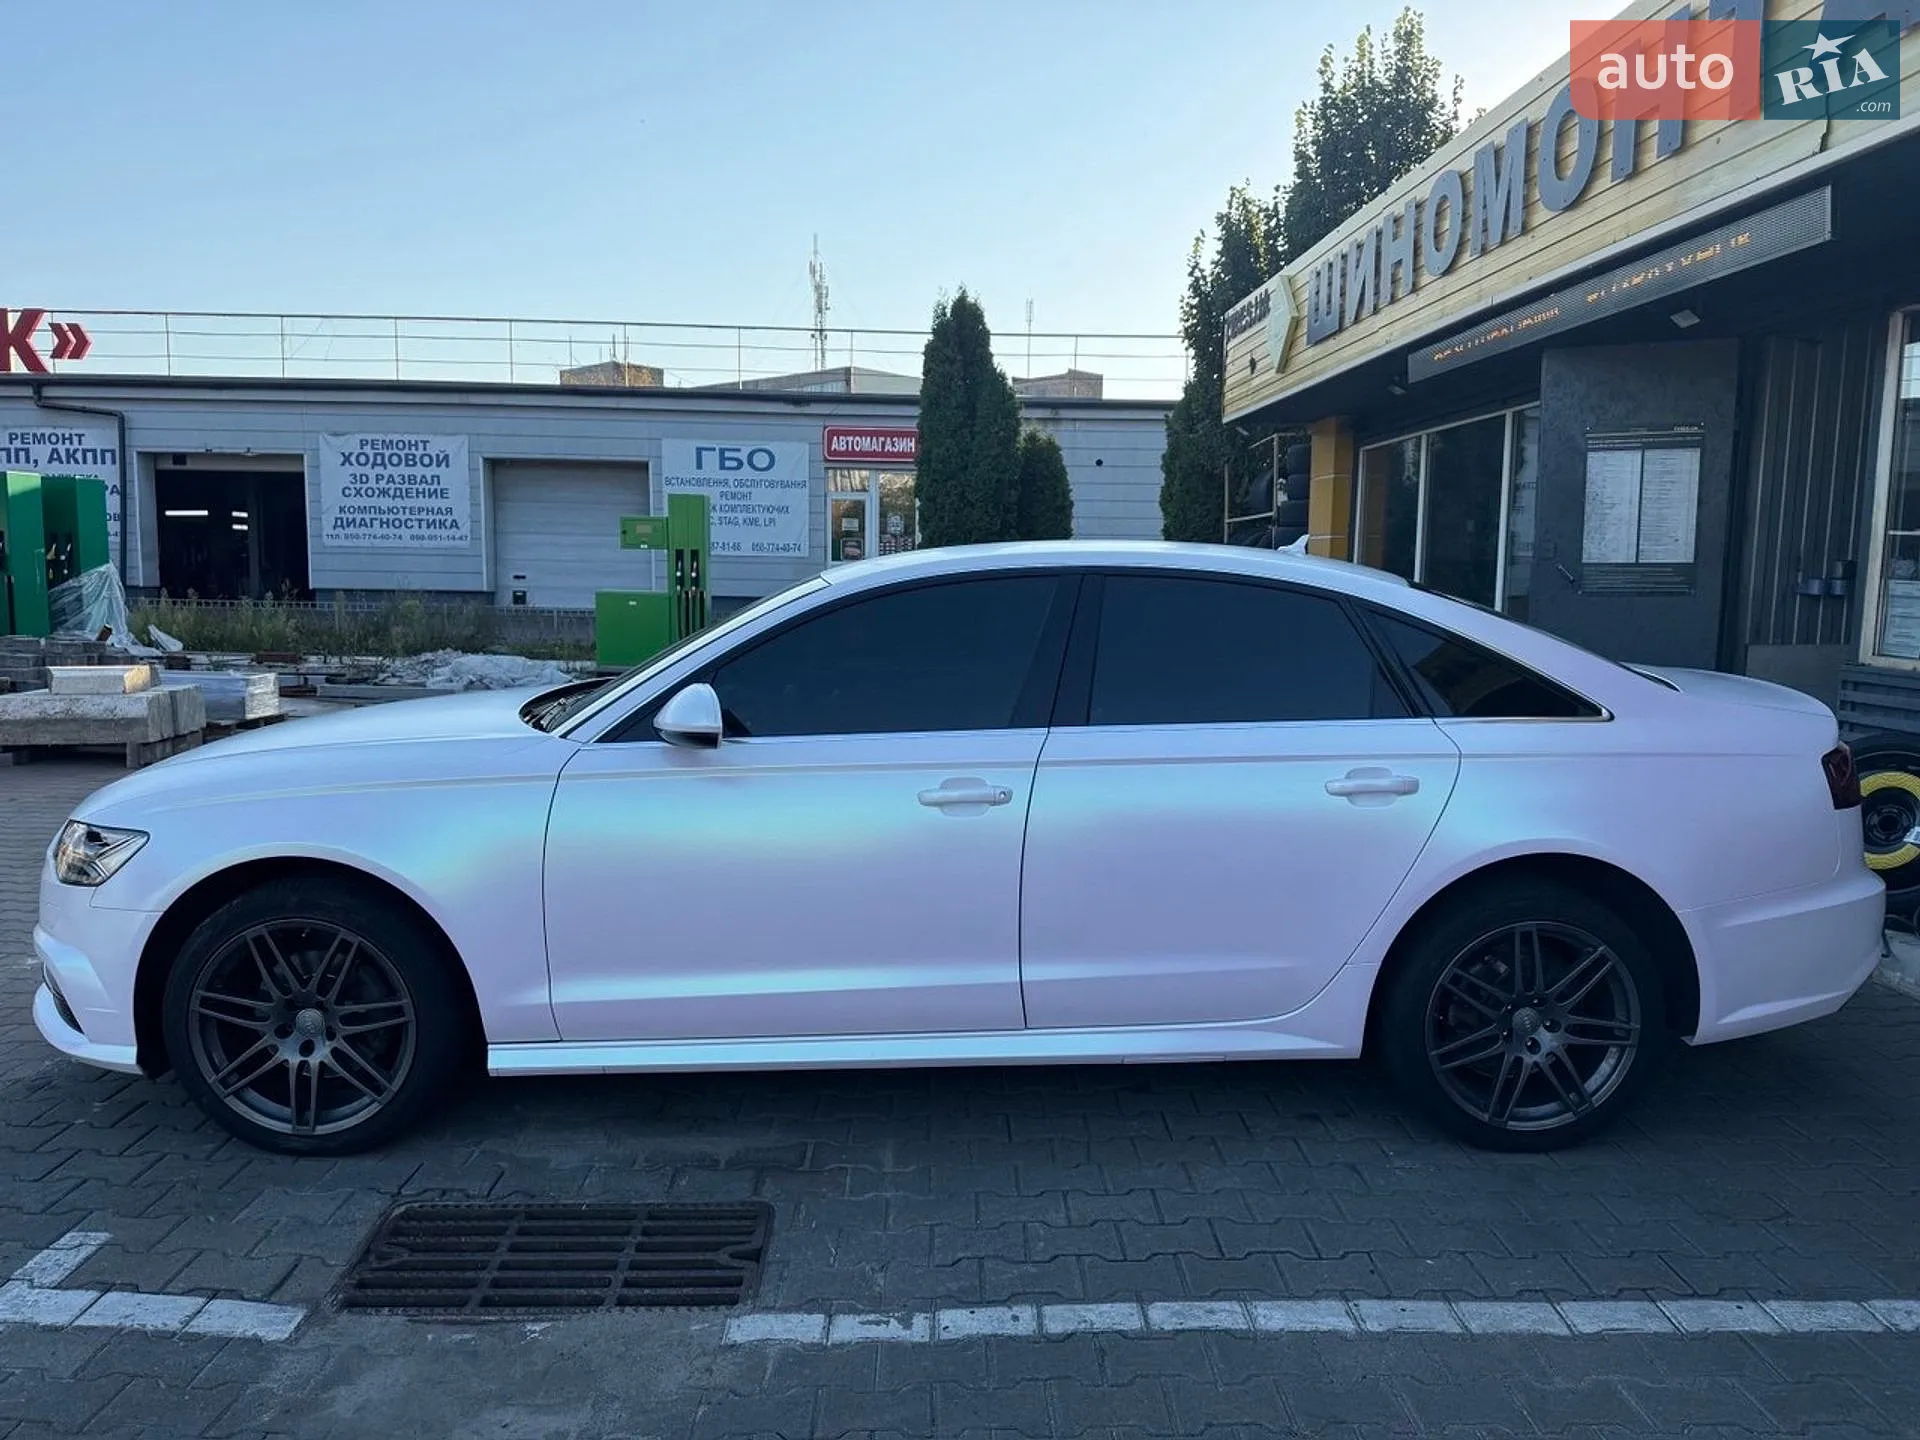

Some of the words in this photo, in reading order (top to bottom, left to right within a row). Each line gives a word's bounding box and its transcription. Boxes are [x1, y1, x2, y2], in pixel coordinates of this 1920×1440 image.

[8, 432, 85, 446] РЕМОНТ
[359, 438, 430, 451] РЕМОНТ
[831, 435, 916, 453] АВТОМАГАЗИН
[46, 447, 117, 465] АКПП
[339, 449, 450, 470] ХОДОВОЙ
[695, 446, 776, 472] ГБО
[349, 473, 369, 485] 3D
[375, 473, 441, 486] РАЗВАЛ
[341, 486, 450, 500] СХОЖДЕНИЕ
[719, 491, 753, 501] РЕМОНТ
[338, 505, 453, 516] КОМПЬЮТЕРНАЯ
[333, 516, 461, 531] ДИАГНОСТИКА
